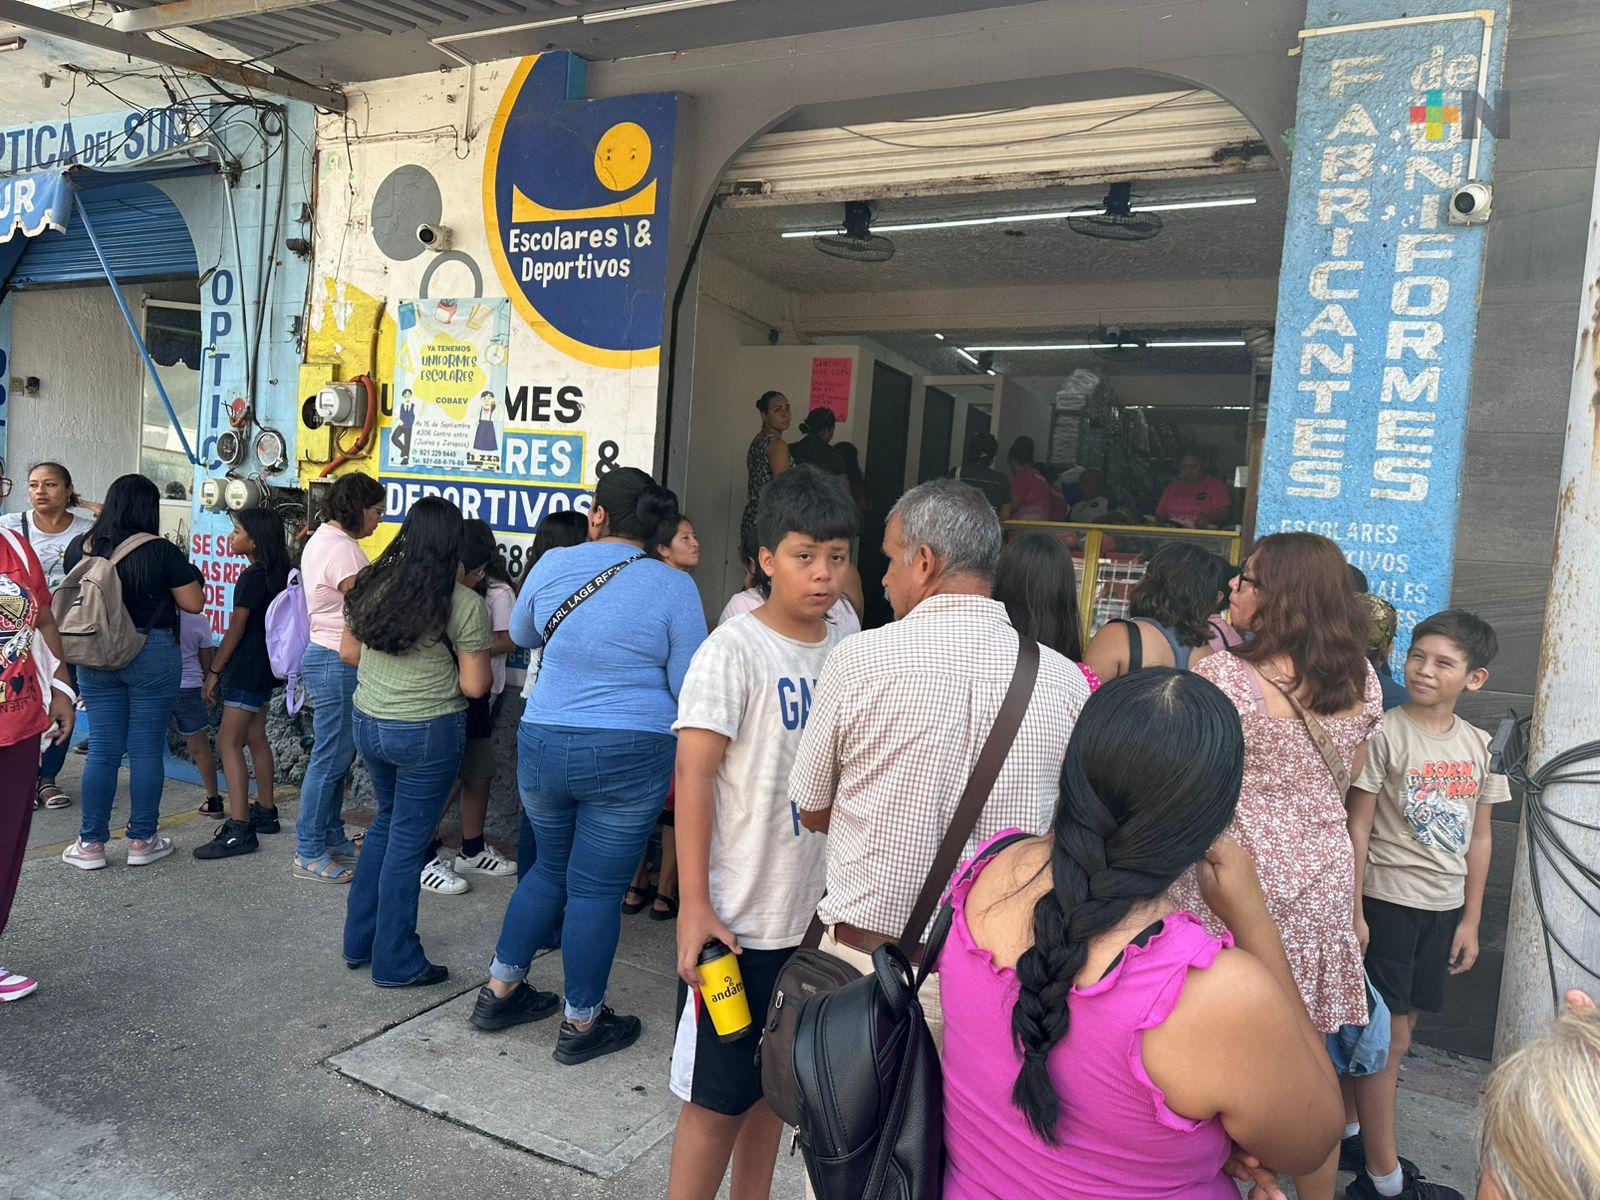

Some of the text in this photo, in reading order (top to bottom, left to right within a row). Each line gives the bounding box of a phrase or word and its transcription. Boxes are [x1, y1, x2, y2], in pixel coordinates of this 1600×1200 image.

[1410, 45, 1479, 91] de
[0, 122, 79, 173] TICA
[83, 130, 117, 163] DEL
[509, 218, 652, 253] Escolares &
[521, 252, 632, 288] Deportivos
[1286, 54, 1387, 499] FABRICANTES
[202, 269, 234, 471] OPTIC
[421, 354, 478, 368] UNIFORMES
[420, 369, 474, 383] ESCOLARES
[435, 397, 468, 405] COBAEV
[192, 534, 212, 556] SE
[193, 559, 222, 582] AS
[1345, 551, 1411, 574] TIVOS
[204, 584, 225, 607] DE
[1369, 580, 1430, 604] ALES
[547, 607, 569, 632] KARL
[777, 677, 817, 731] GA
[1423, 760, 1475, 780] BORN
[1445, 779, 1479, 799] RID
